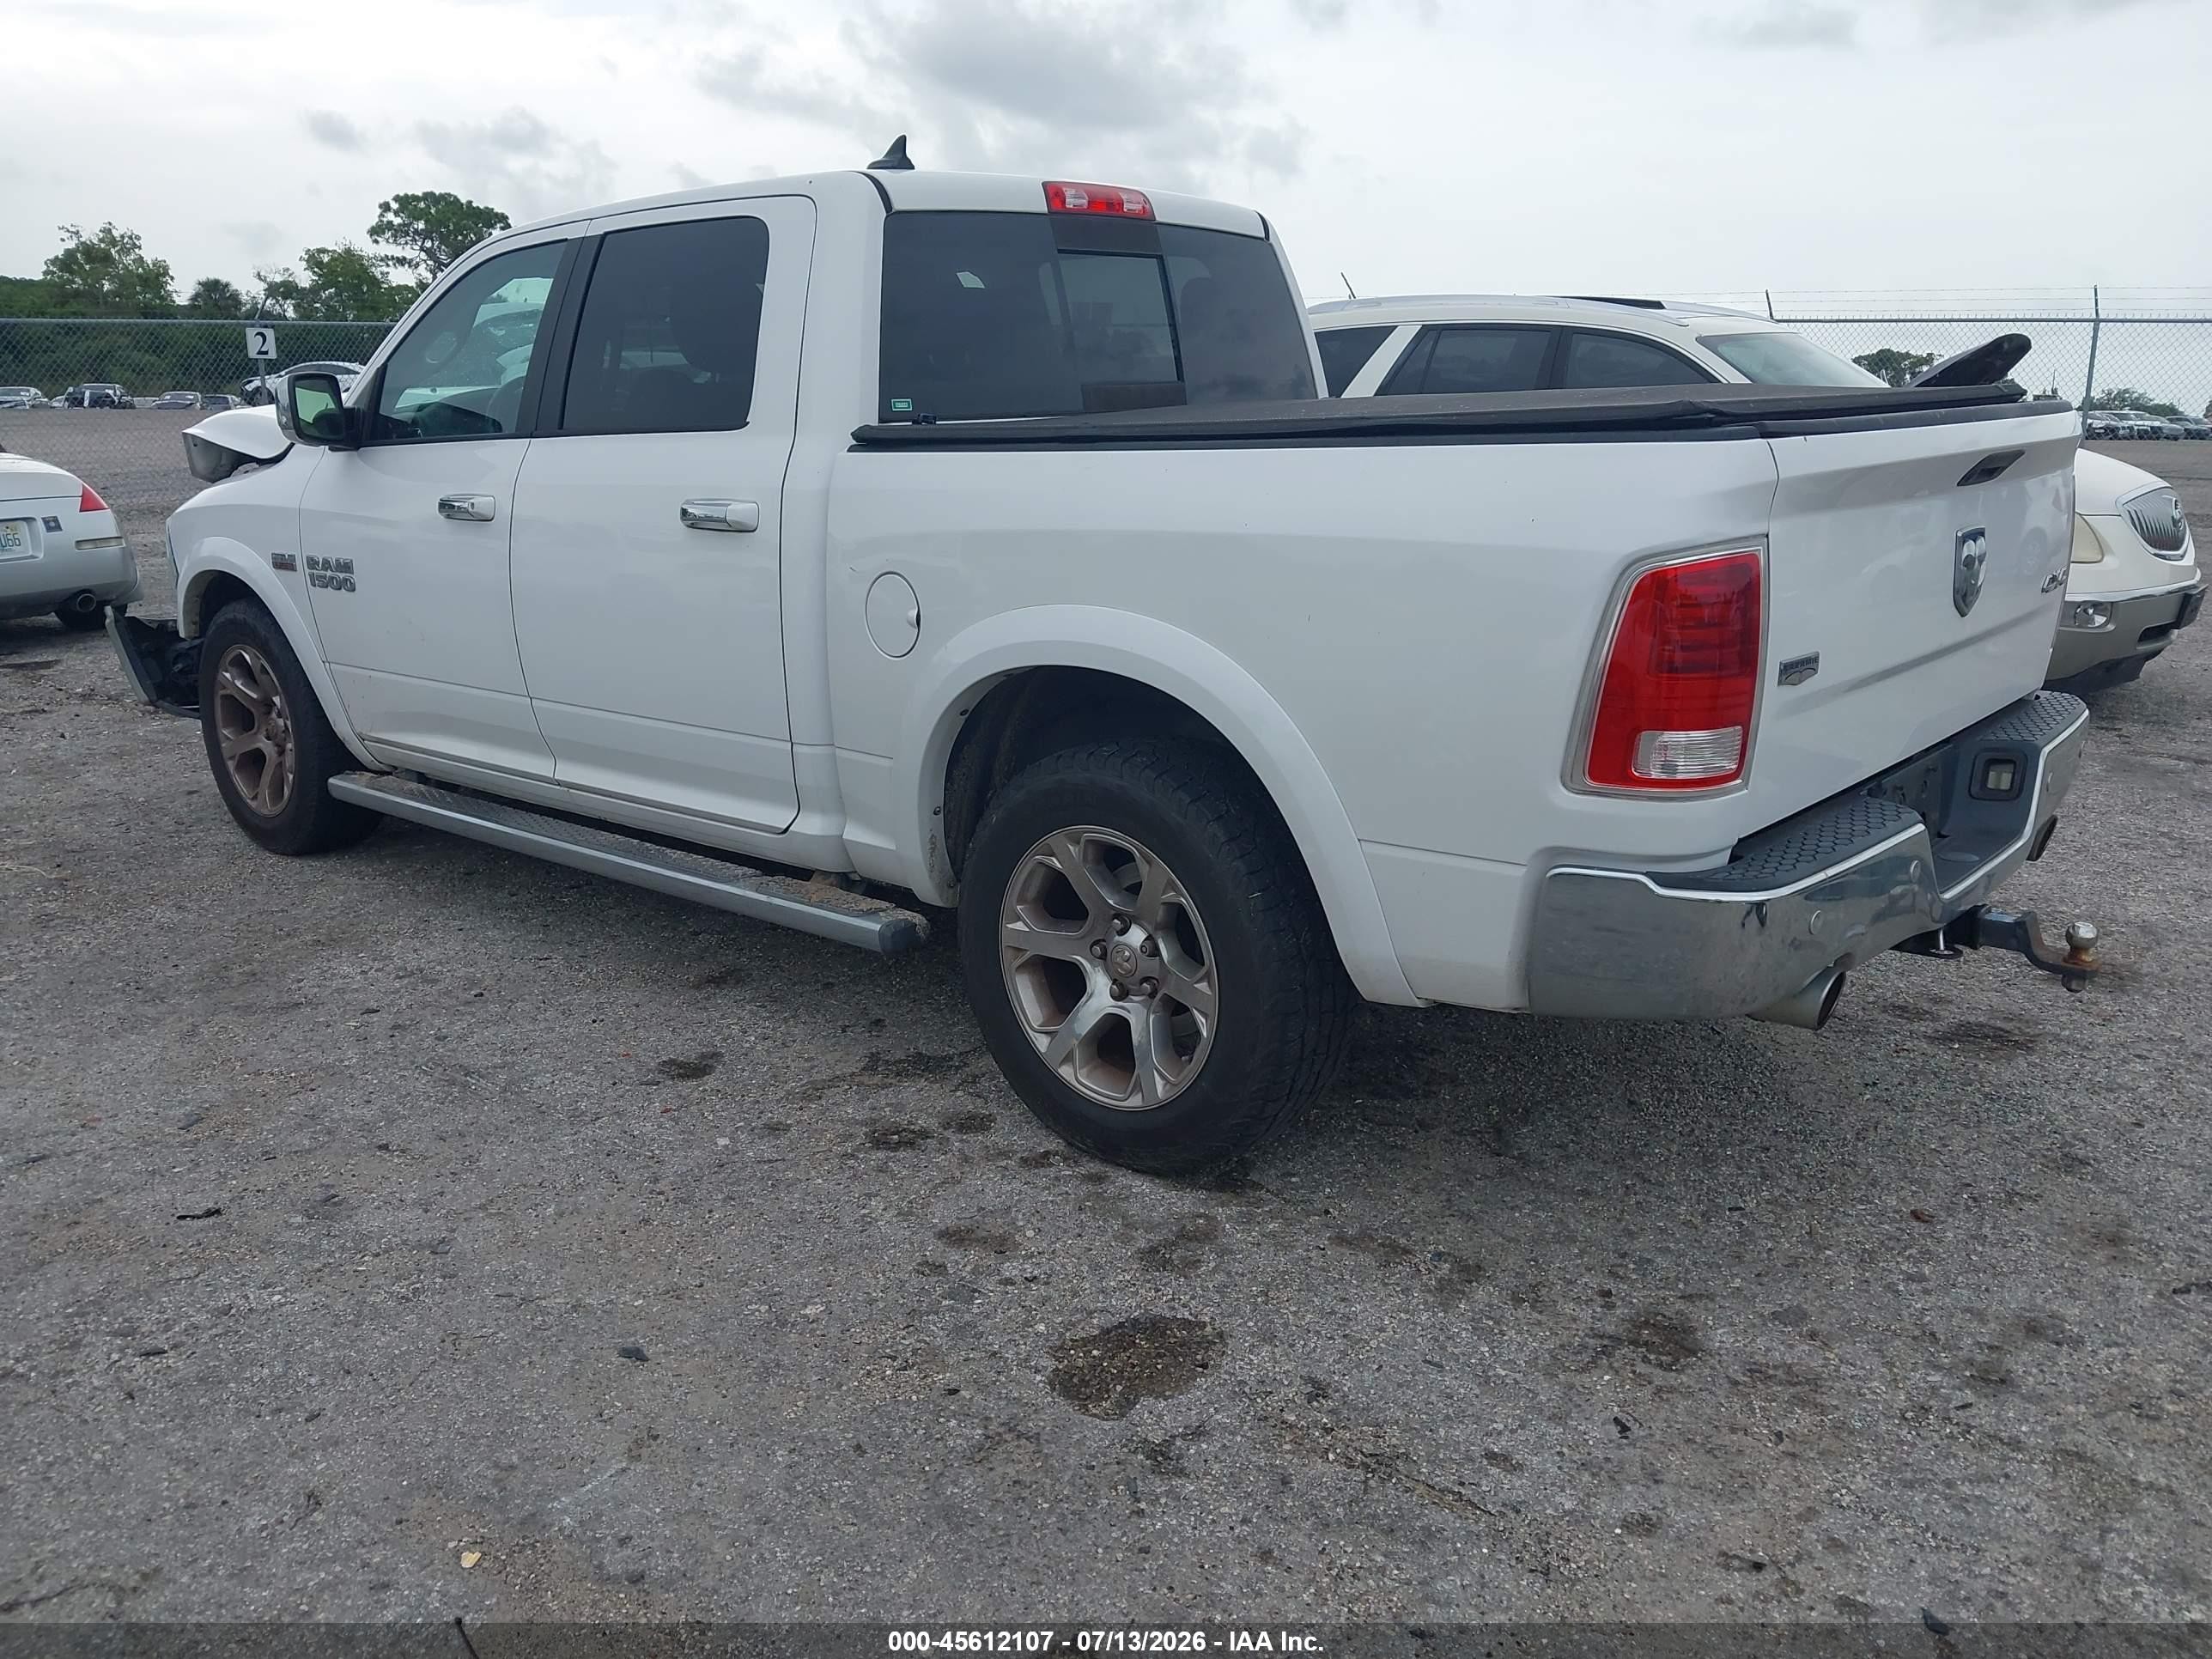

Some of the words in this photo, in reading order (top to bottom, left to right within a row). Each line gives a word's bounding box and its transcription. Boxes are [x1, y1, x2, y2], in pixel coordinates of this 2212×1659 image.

[253, 331, 269, 355] 2
[306, 556, 354, 574] RAM
[308, 571, 356, 592] 1500
